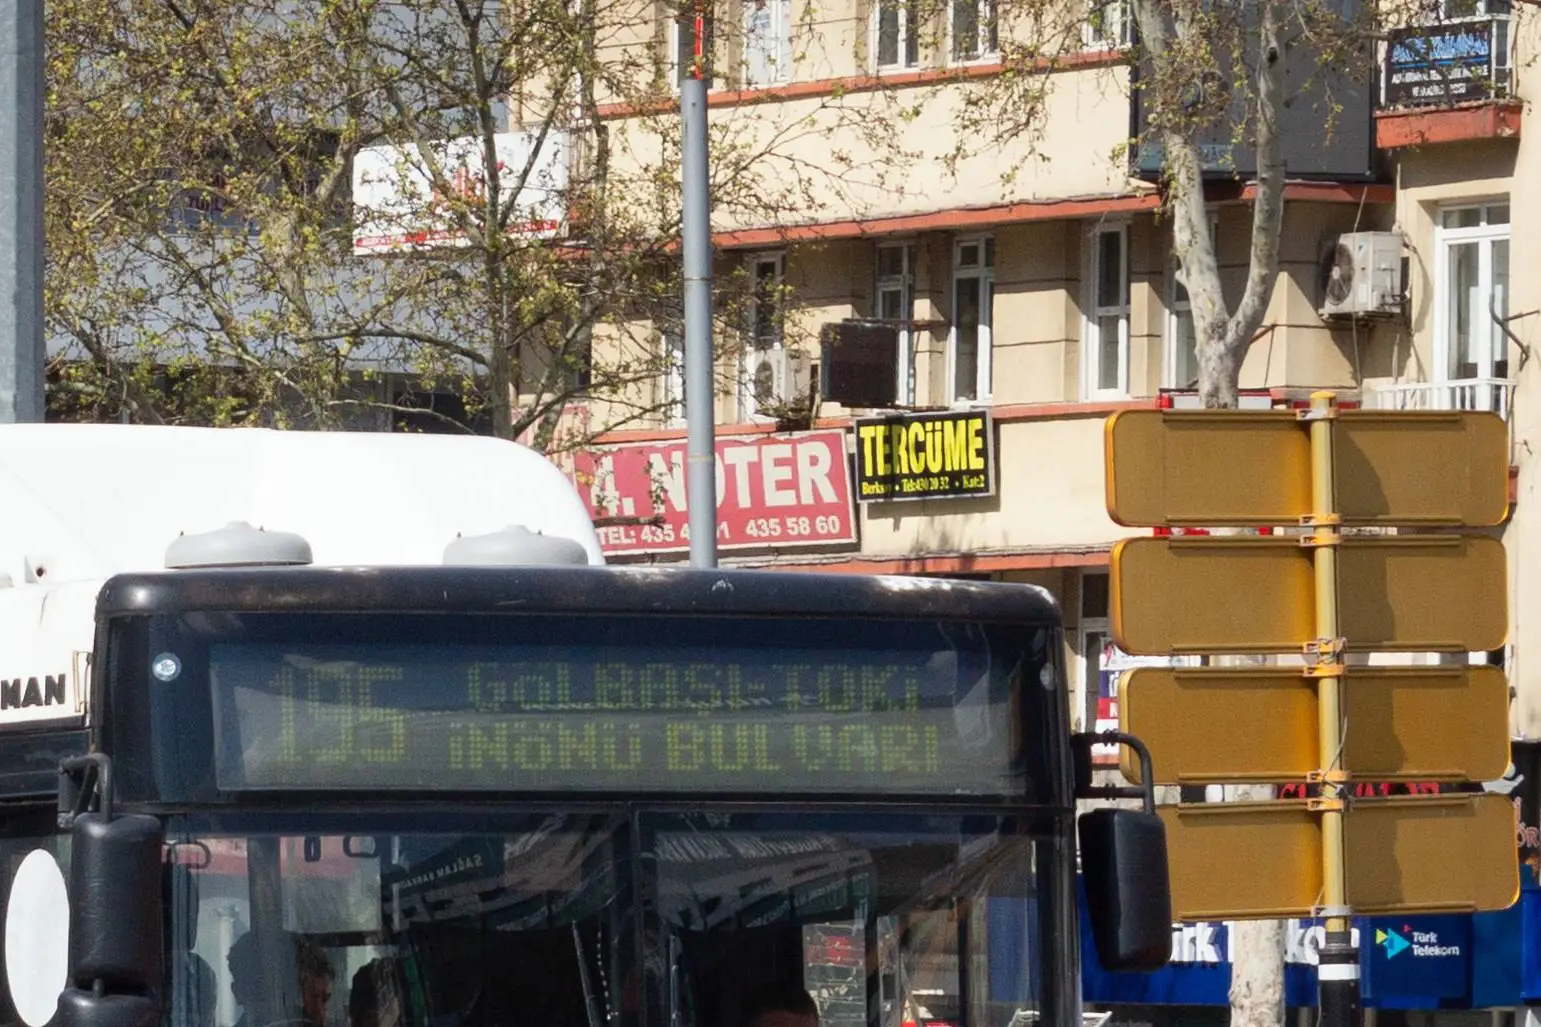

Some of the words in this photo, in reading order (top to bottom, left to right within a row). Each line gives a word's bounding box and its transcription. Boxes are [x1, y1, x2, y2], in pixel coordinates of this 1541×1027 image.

[649, 440, 842, 514] NTER
[746, 515, 781, 537] 435
[787, 514, 811, 536] 58
[816, 514, 841, 535] 60
[1, 673, 66, 710] MAN
[276, 666, 406, 763] 195
[666, 723, 939, 772] BULVARI
[1412, 931, 1438, 943] Türk
[1412, 944, 1460, 957] Telekom
